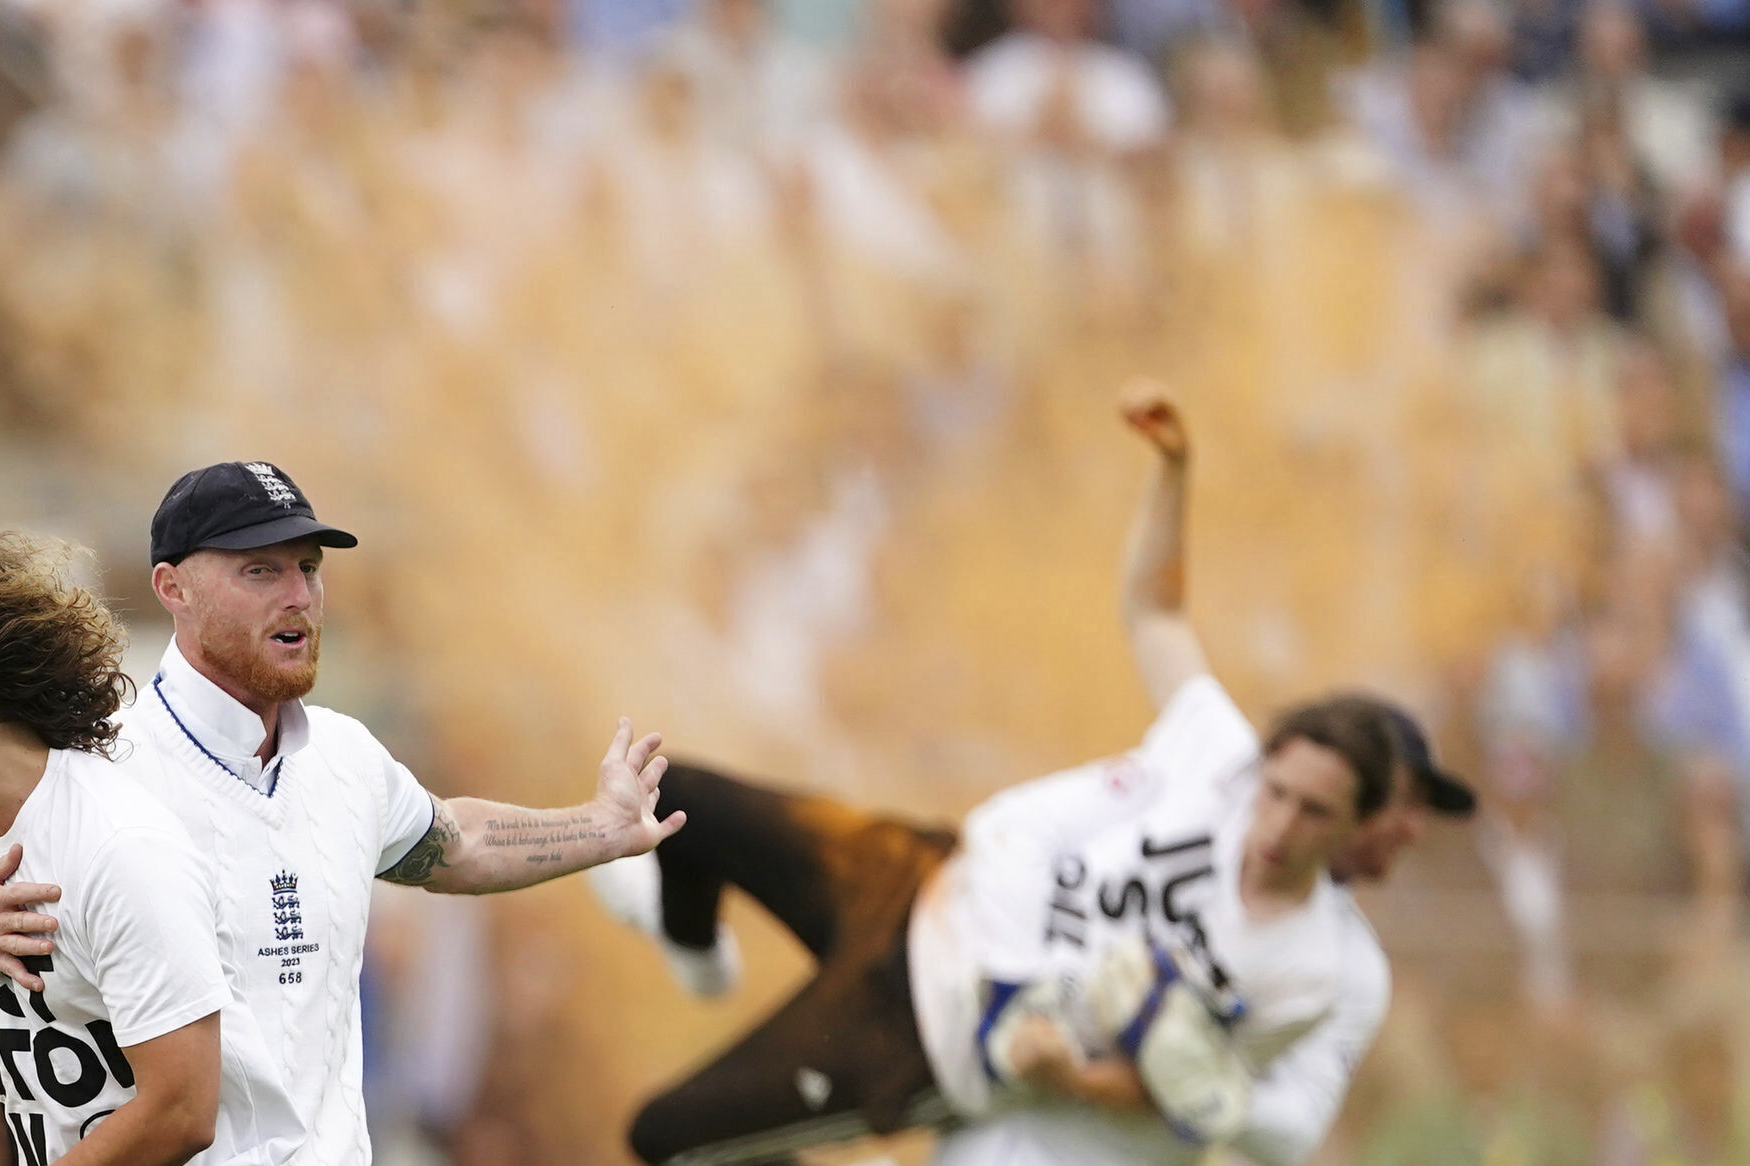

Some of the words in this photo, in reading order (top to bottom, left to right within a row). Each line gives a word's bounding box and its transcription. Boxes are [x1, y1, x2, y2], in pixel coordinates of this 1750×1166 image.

[257, 946, 289, 957] ASHES
[291, 943, 319, 955] SERIES
[281, 957, 300, 967] 2023
[278, 972, 302, 984] 658
